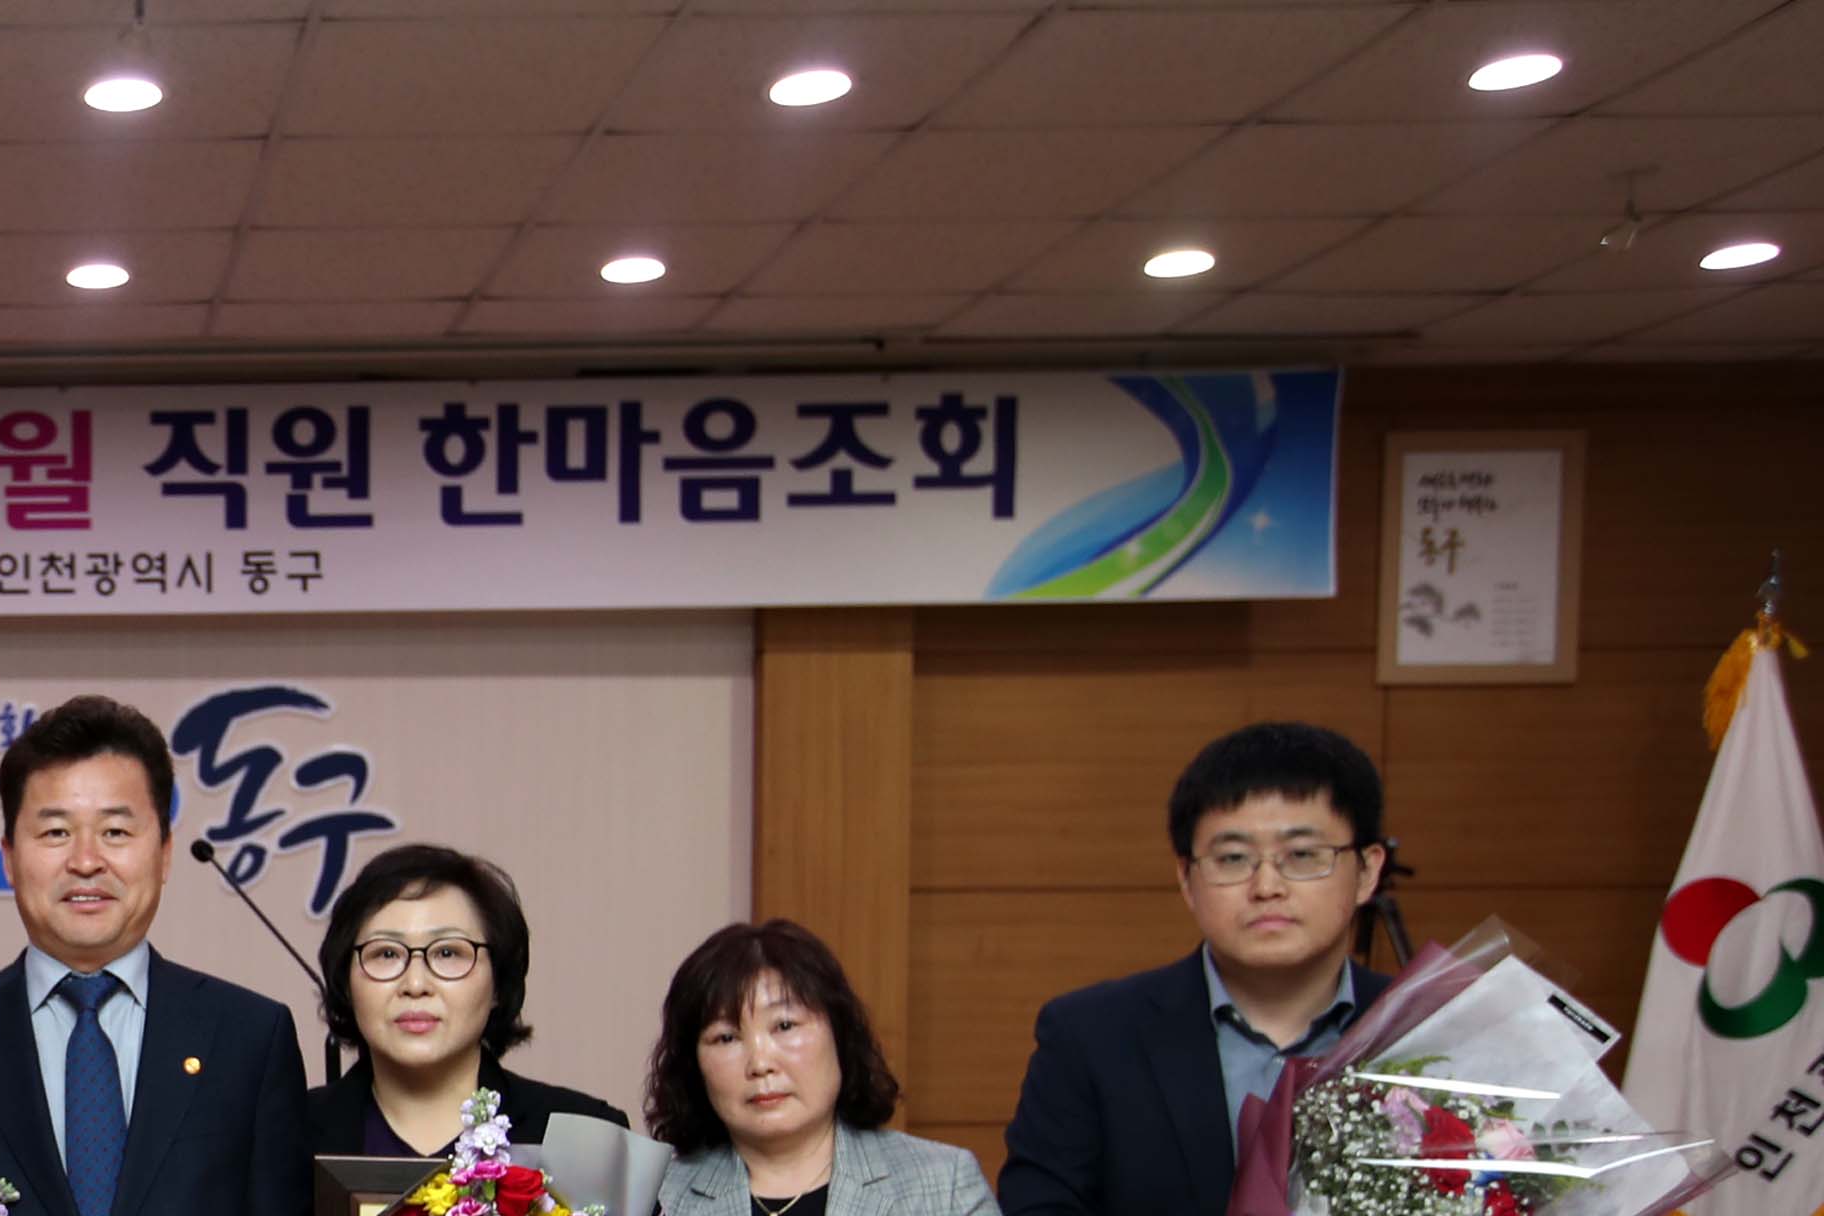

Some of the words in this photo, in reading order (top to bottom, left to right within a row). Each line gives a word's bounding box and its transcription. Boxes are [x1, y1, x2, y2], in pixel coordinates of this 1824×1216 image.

[143, 405, 374, 530] 직원
[418, 392, 1019, 527] 한마음조회
[241, 551, 322, 595] 동구
[172, 686, 395, 914] 동구
